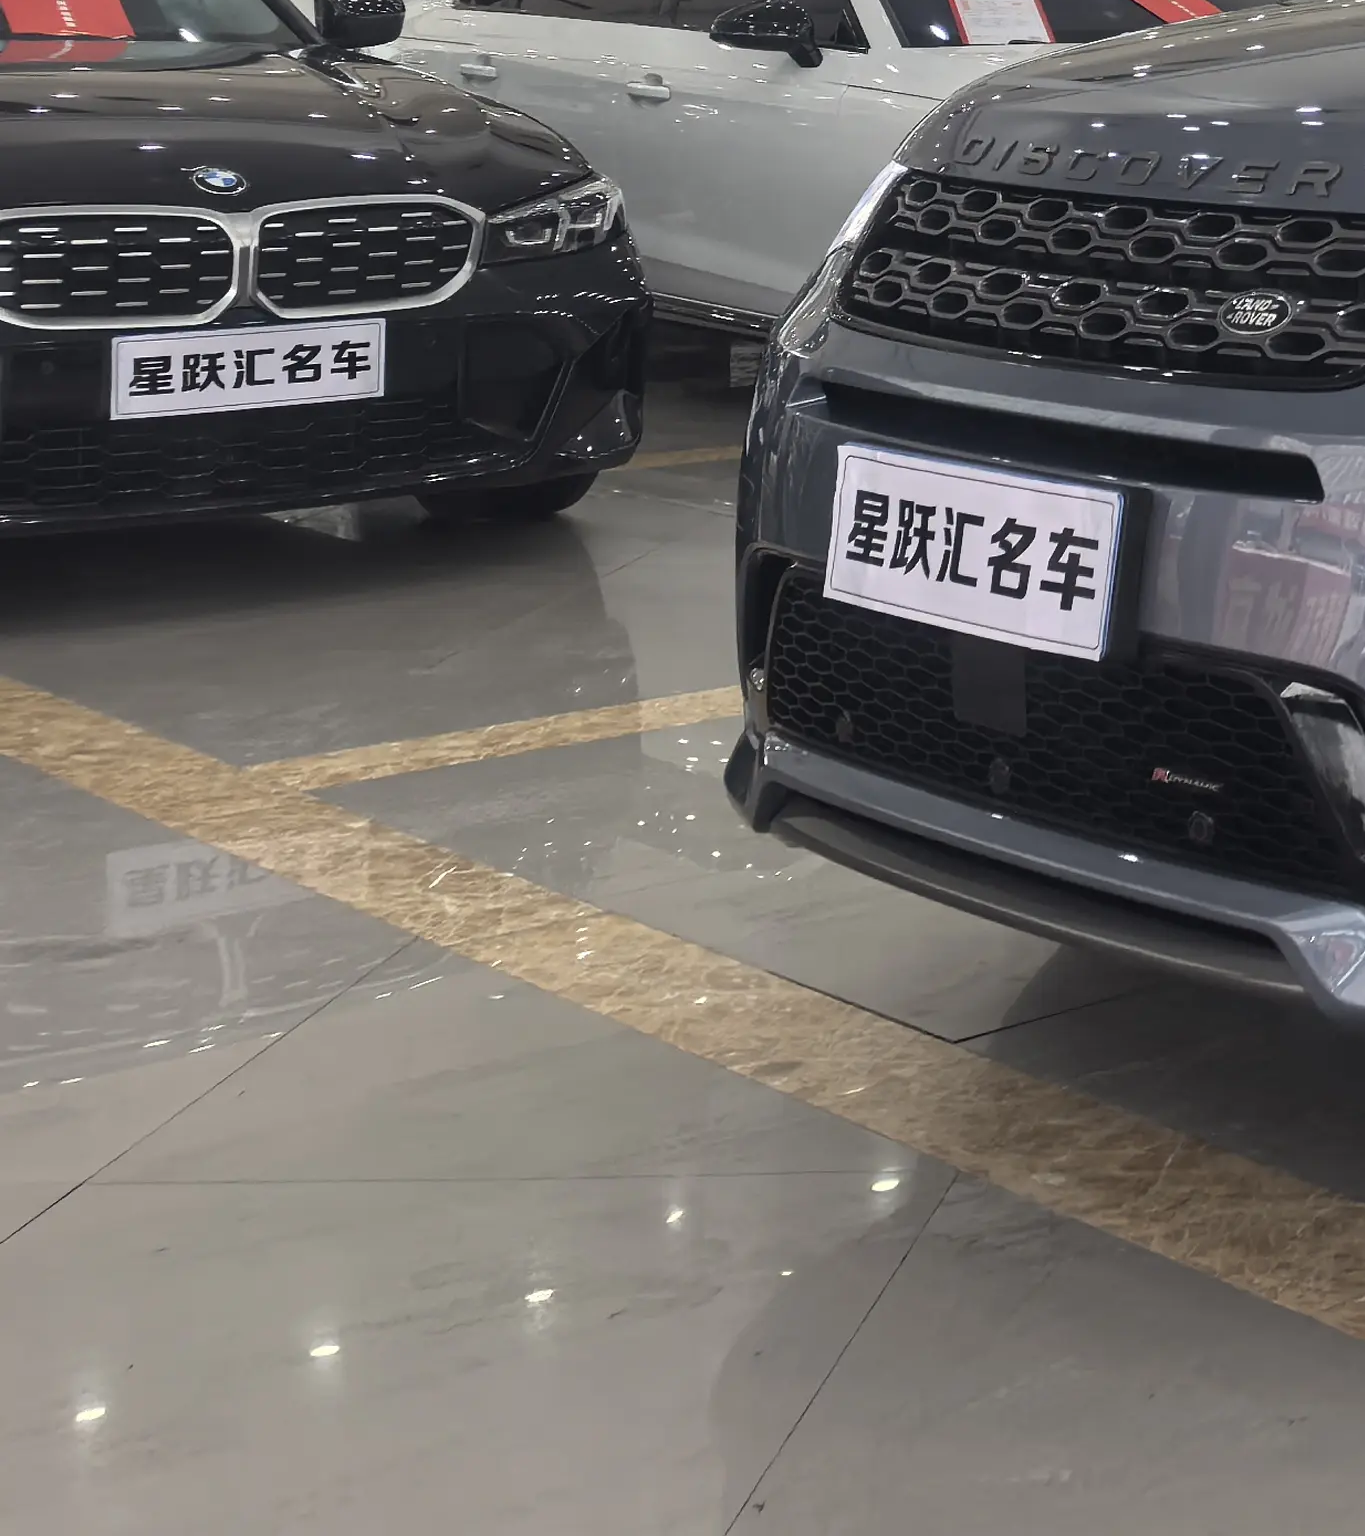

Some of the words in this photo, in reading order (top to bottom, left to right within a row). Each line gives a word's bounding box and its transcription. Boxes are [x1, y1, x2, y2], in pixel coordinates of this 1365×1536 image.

[1230, 312, 1278, 327] ROVER
[1234, 297, 1273, 311] LAND
[128, 340, 372, 397] 星跃汇名车
[845, 489, 1100, 611] 星跃汇名车
